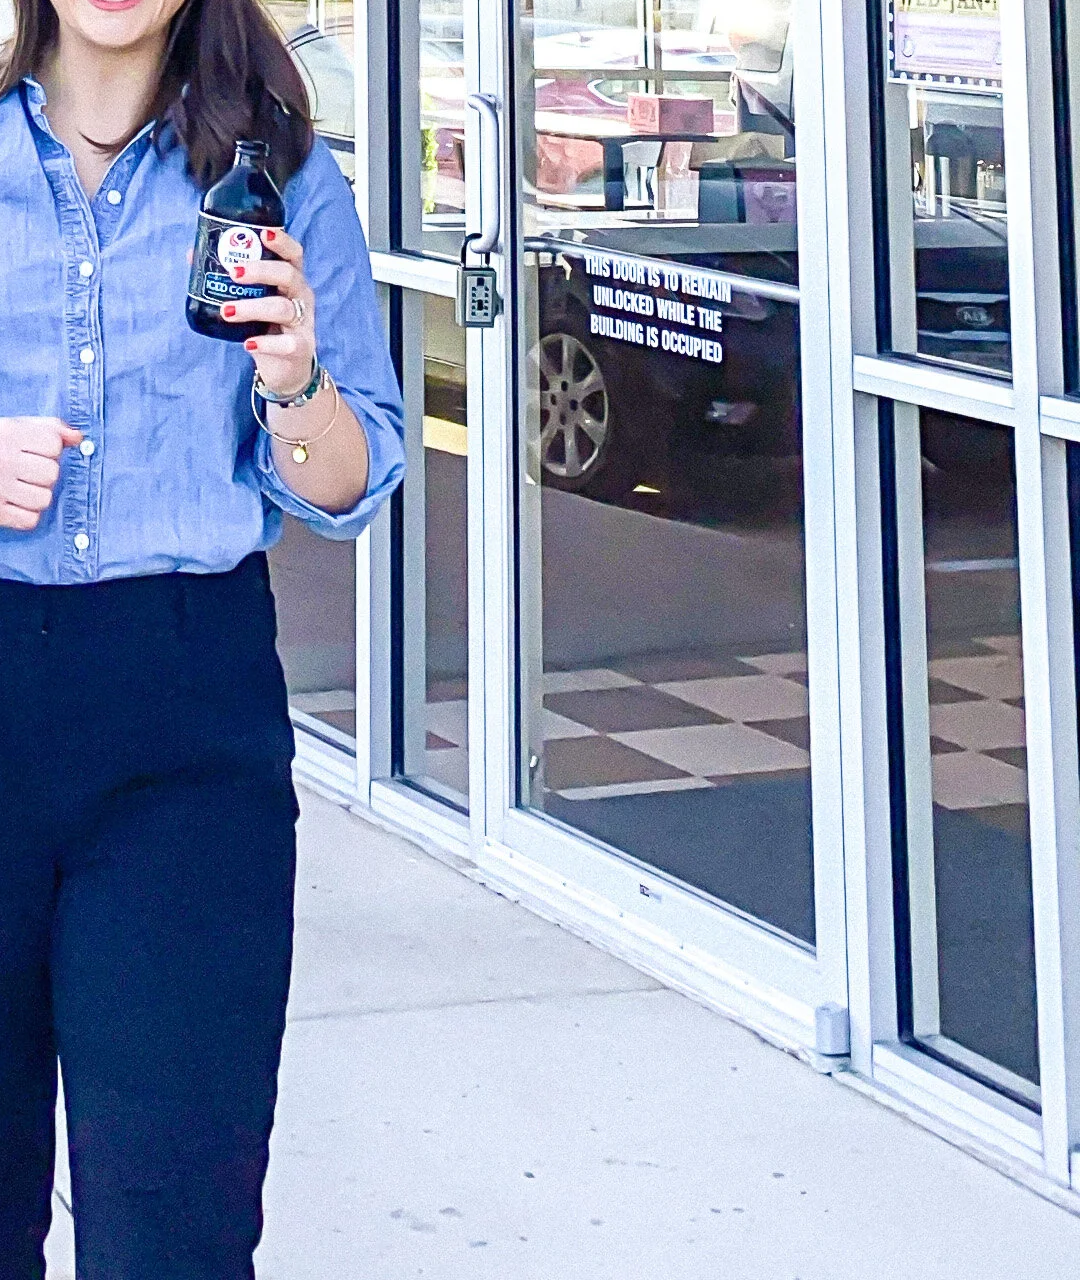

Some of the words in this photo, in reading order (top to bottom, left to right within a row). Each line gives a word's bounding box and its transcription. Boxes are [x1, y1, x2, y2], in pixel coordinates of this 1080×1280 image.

[206, 279, 228, 293] ICED
[584, 255, 610, 278] THIS
[612, 259, 645, 285] DOOR
[647, 264, 660, 288] IS
[662, 268, 679, 292] TO
[681, 272, 732, 303] REMAIN
[593, 285, 654, 316] UNLOCKED
[655, 297, 695, 326] WHILE
[696, 306, 723, 332] THE
[590, 314, 644, 344] BUILDING
[646, 325, 659, 348] IS
[661, 330, 723, 363] OCCUPIED
